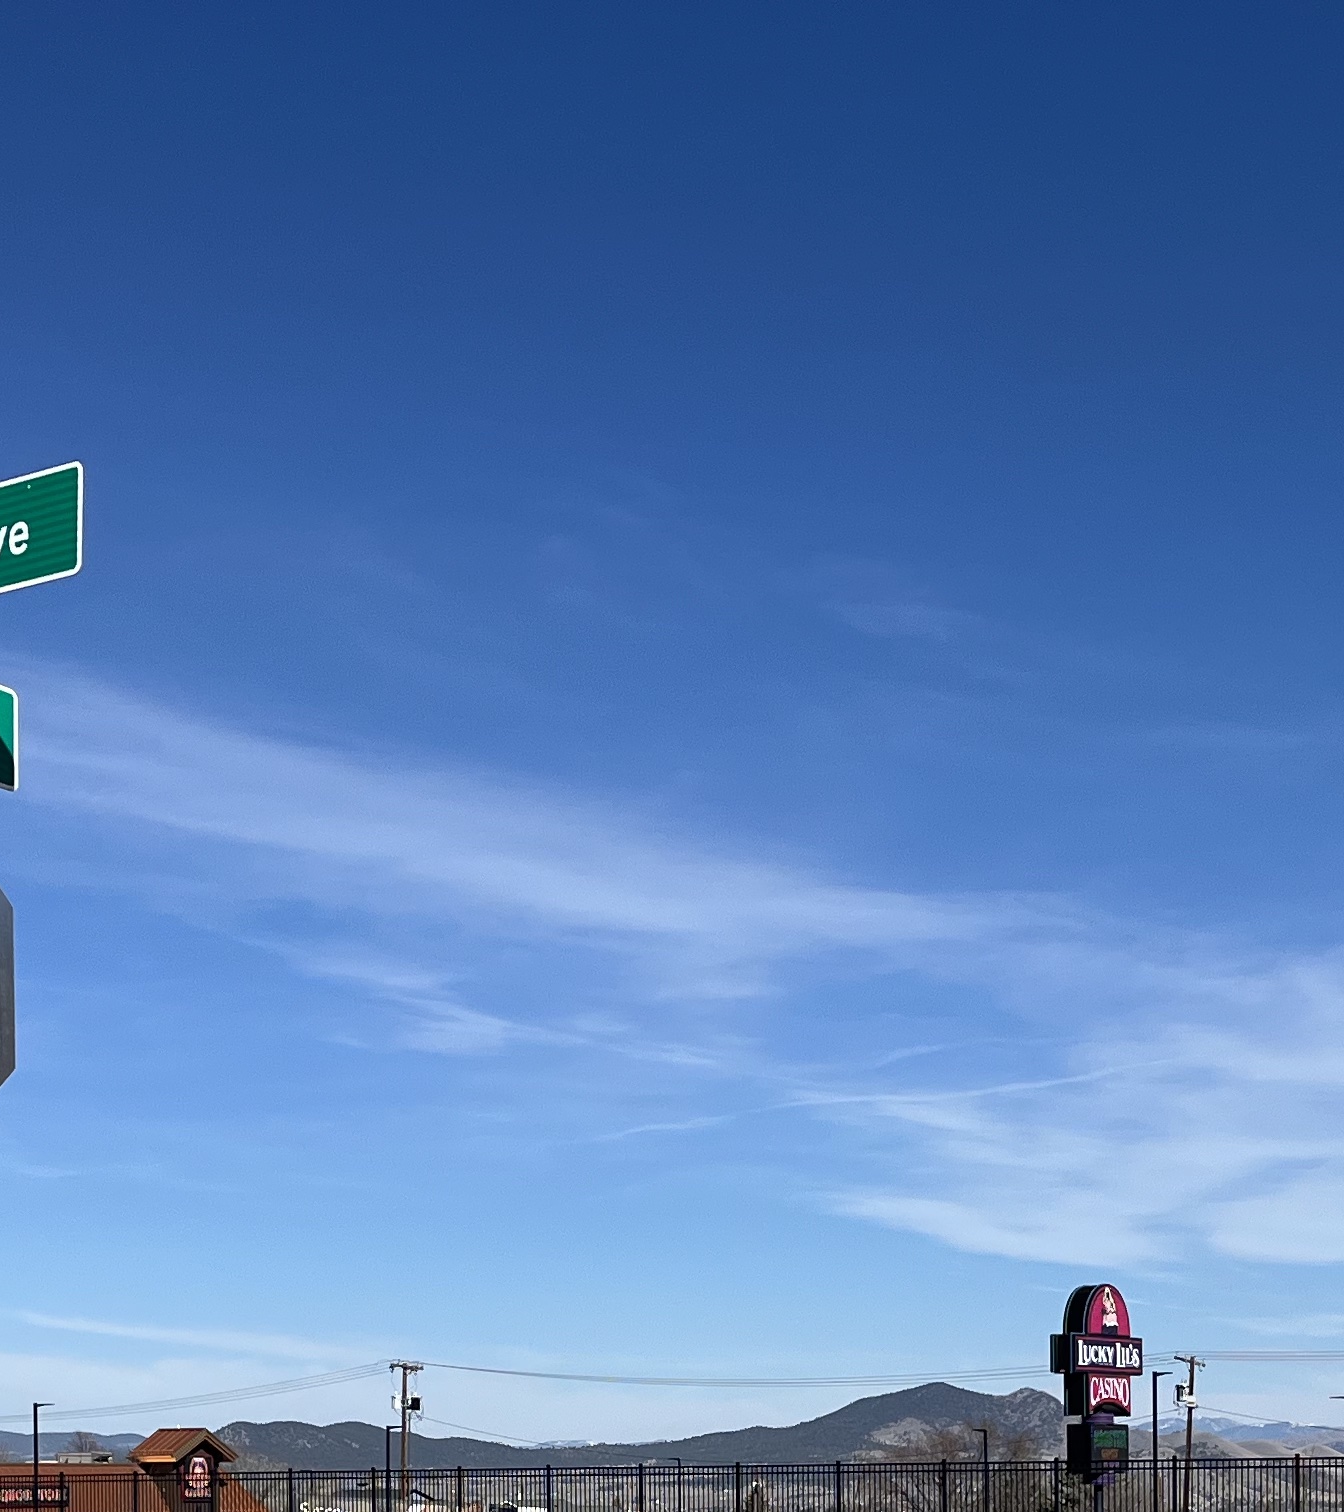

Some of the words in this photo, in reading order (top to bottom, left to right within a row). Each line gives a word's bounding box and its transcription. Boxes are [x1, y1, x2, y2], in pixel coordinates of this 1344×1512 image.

[1077, 1339, 1115, 1366] LUCKY
[1115, 1342, 1140, 1368] LIL'S
[1090, 1376, 1130, 1407] CASINO
